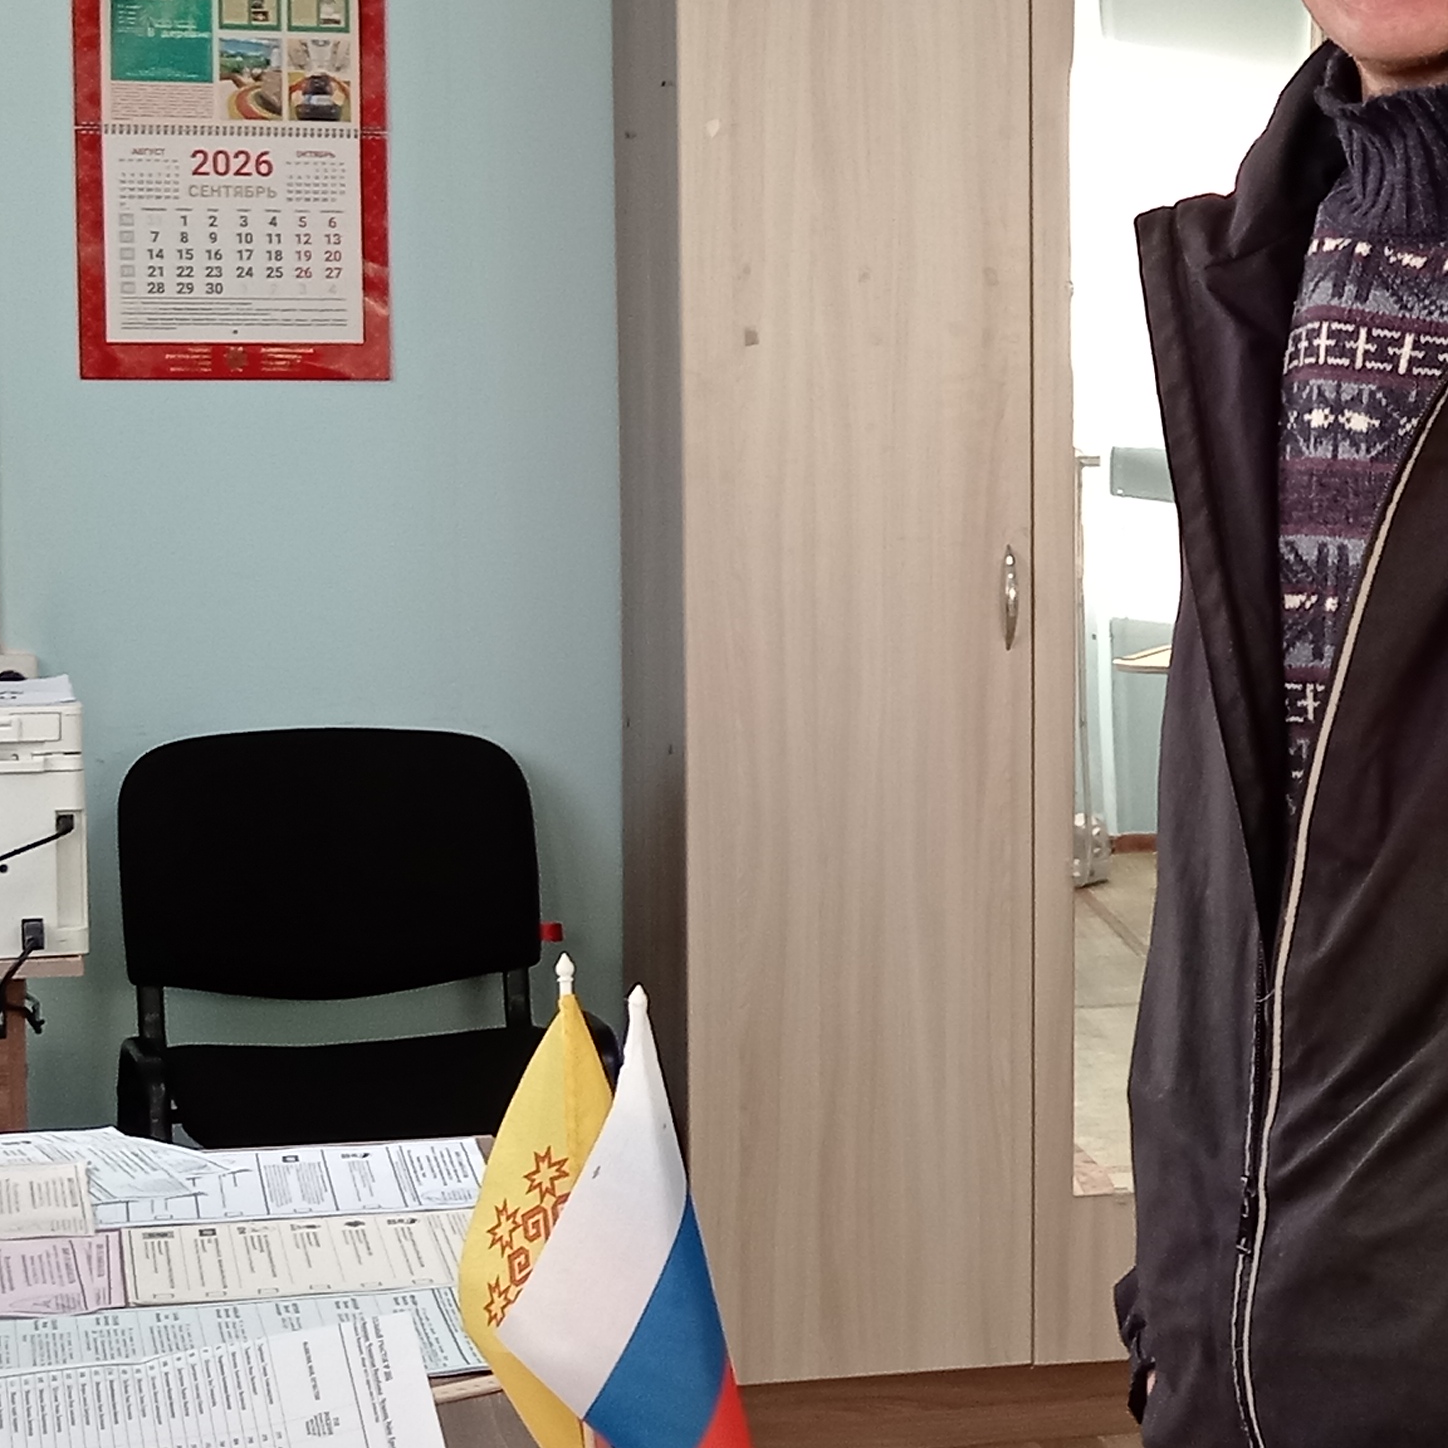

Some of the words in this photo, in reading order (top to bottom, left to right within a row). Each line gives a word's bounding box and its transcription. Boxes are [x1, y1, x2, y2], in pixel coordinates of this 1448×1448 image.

[190, 149, 274, 177] 2026
[188, 184, 278, 199] СЕНТЯБРЬ
[181, 216, 187, 226] 1
[209, 216, 218, 227] 2
[240, 216, 248, 227] 3
[269, 216, 277, 227] 4
[299, 217, 306, 227] 5
[329, 217, 337, 228] 6
[152, 232, 159, 243] 7
[180, 232, 188, 243] 8
[210, 232, 217, 243] 9
[237, 233, 253, 244] 10
[267, 233, 282, 244] 11
[295, 234, 311, 245] 12
[325, 234, 341, 245] 13
[148, 249, 163, 260] 14
[177, 249, 193, 260] 15
[206, 249, 222, 260] 16
[237, 250, 253, 261] 17
[267, 250, 283, 261] 18
[296, 251, 311, 261] 19
[325, 251, 341, 262] 20
[148, 266, 163, 277] 21
[177, 266, 194, 277] 22
[206, 267, 223, 277] 23
[236, 267, 253, 278] 24
[267, 267, 283, 278] 25
[295, 268, 312, 278] 26
[325, 268, 342, 278] 27
[148, 283, 165, 294] 28
[177, 283, 194, 294] 29
[206, 284, 223, 294] 30
